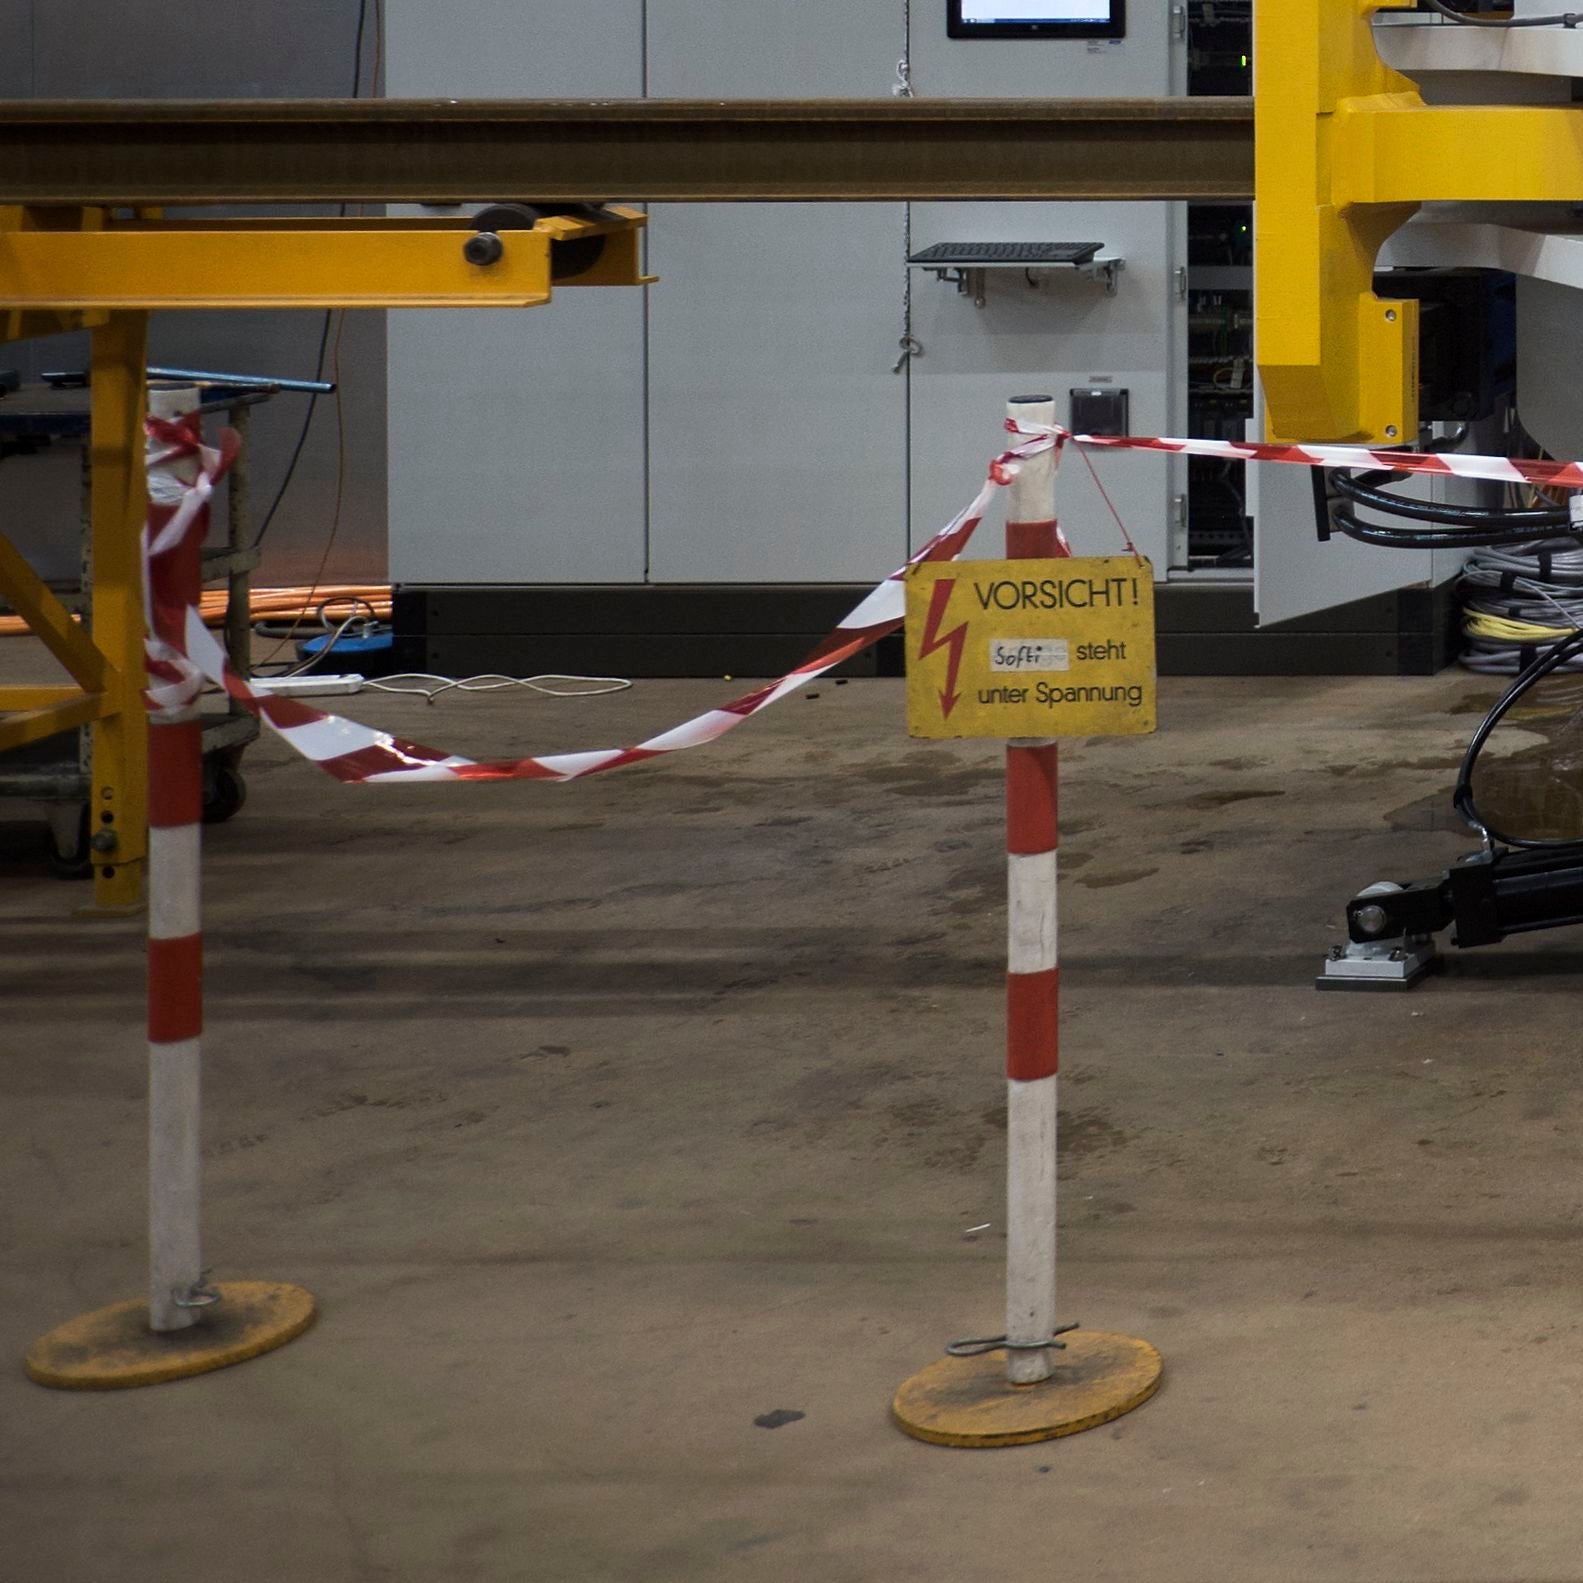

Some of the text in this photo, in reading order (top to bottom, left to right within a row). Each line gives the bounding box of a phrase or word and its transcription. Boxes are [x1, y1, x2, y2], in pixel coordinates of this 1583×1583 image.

[974, 578, 1139, 610] VORSICHT!
[1076, 639, 1127, 661] steht
[978, 681, 1143, 709] unter Spannung
